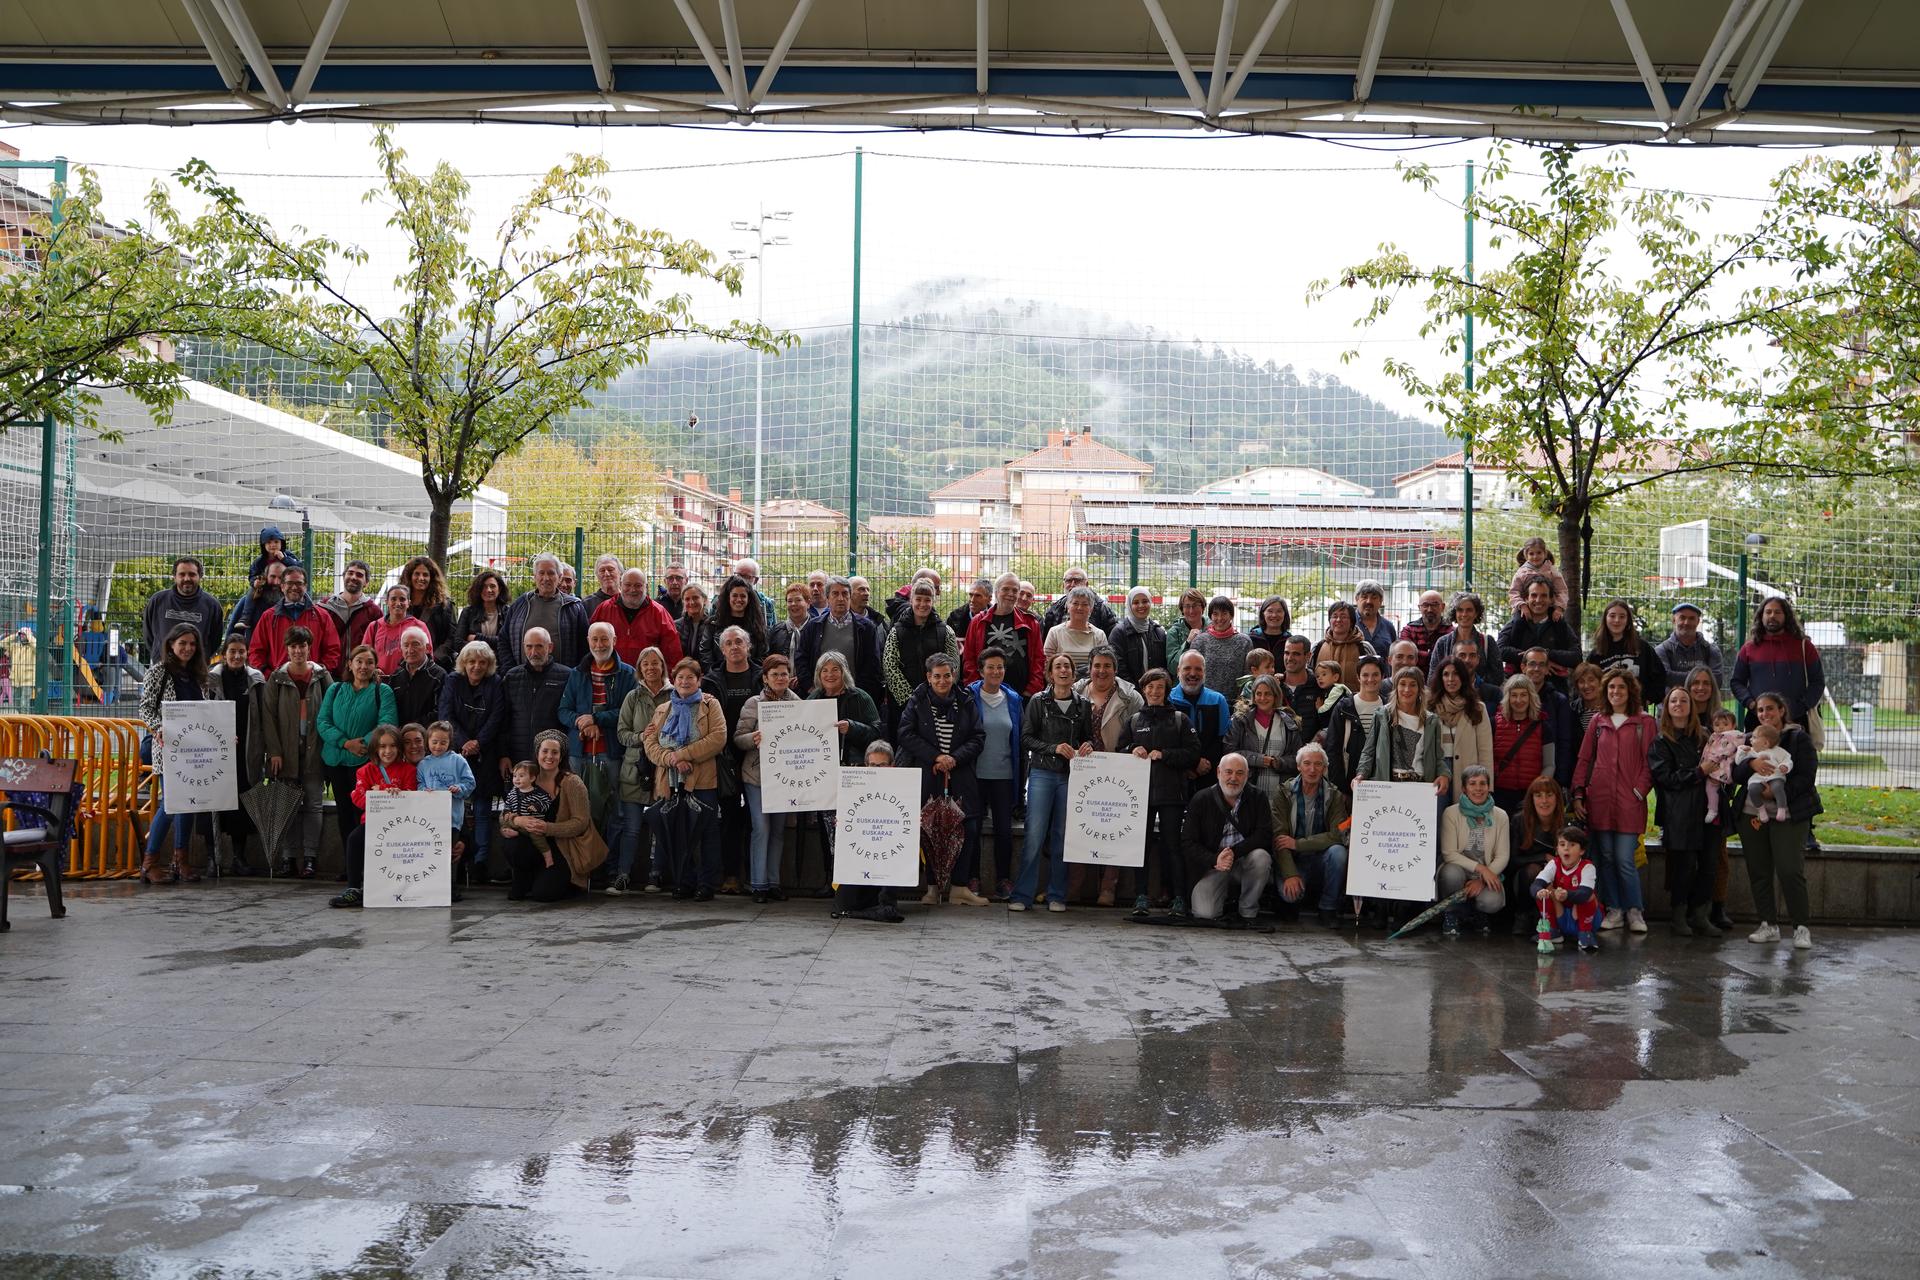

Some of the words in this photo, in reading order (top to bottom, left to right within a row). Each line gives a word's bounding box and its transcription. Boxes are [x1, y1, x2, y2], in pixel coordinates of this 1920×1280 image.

[170, 722, 228, 762] OLDARRALDIAREN
[769, 723, 831, 763] OLDARRALDIAREN
[176, 768, 224, 786] AURREAN
[774, 769, 827, 787] AURREAN
[1075, 776, 1138, 817] OLDARRALDIAREN
[845, 792, 911, 834] OLDARRALDIAREN
[1361, 805, 1427, 847] OLDARRALDIAREN
[375, 815, 442, 856] OLDARRALDIAREN
[1079, 823, 1132, 840] AURREAN
[849, 842, 904, 860] AURREAN
[1365, 854, 1421, 872] AURREAN
[379, 864, 436, 882] AURREAN
